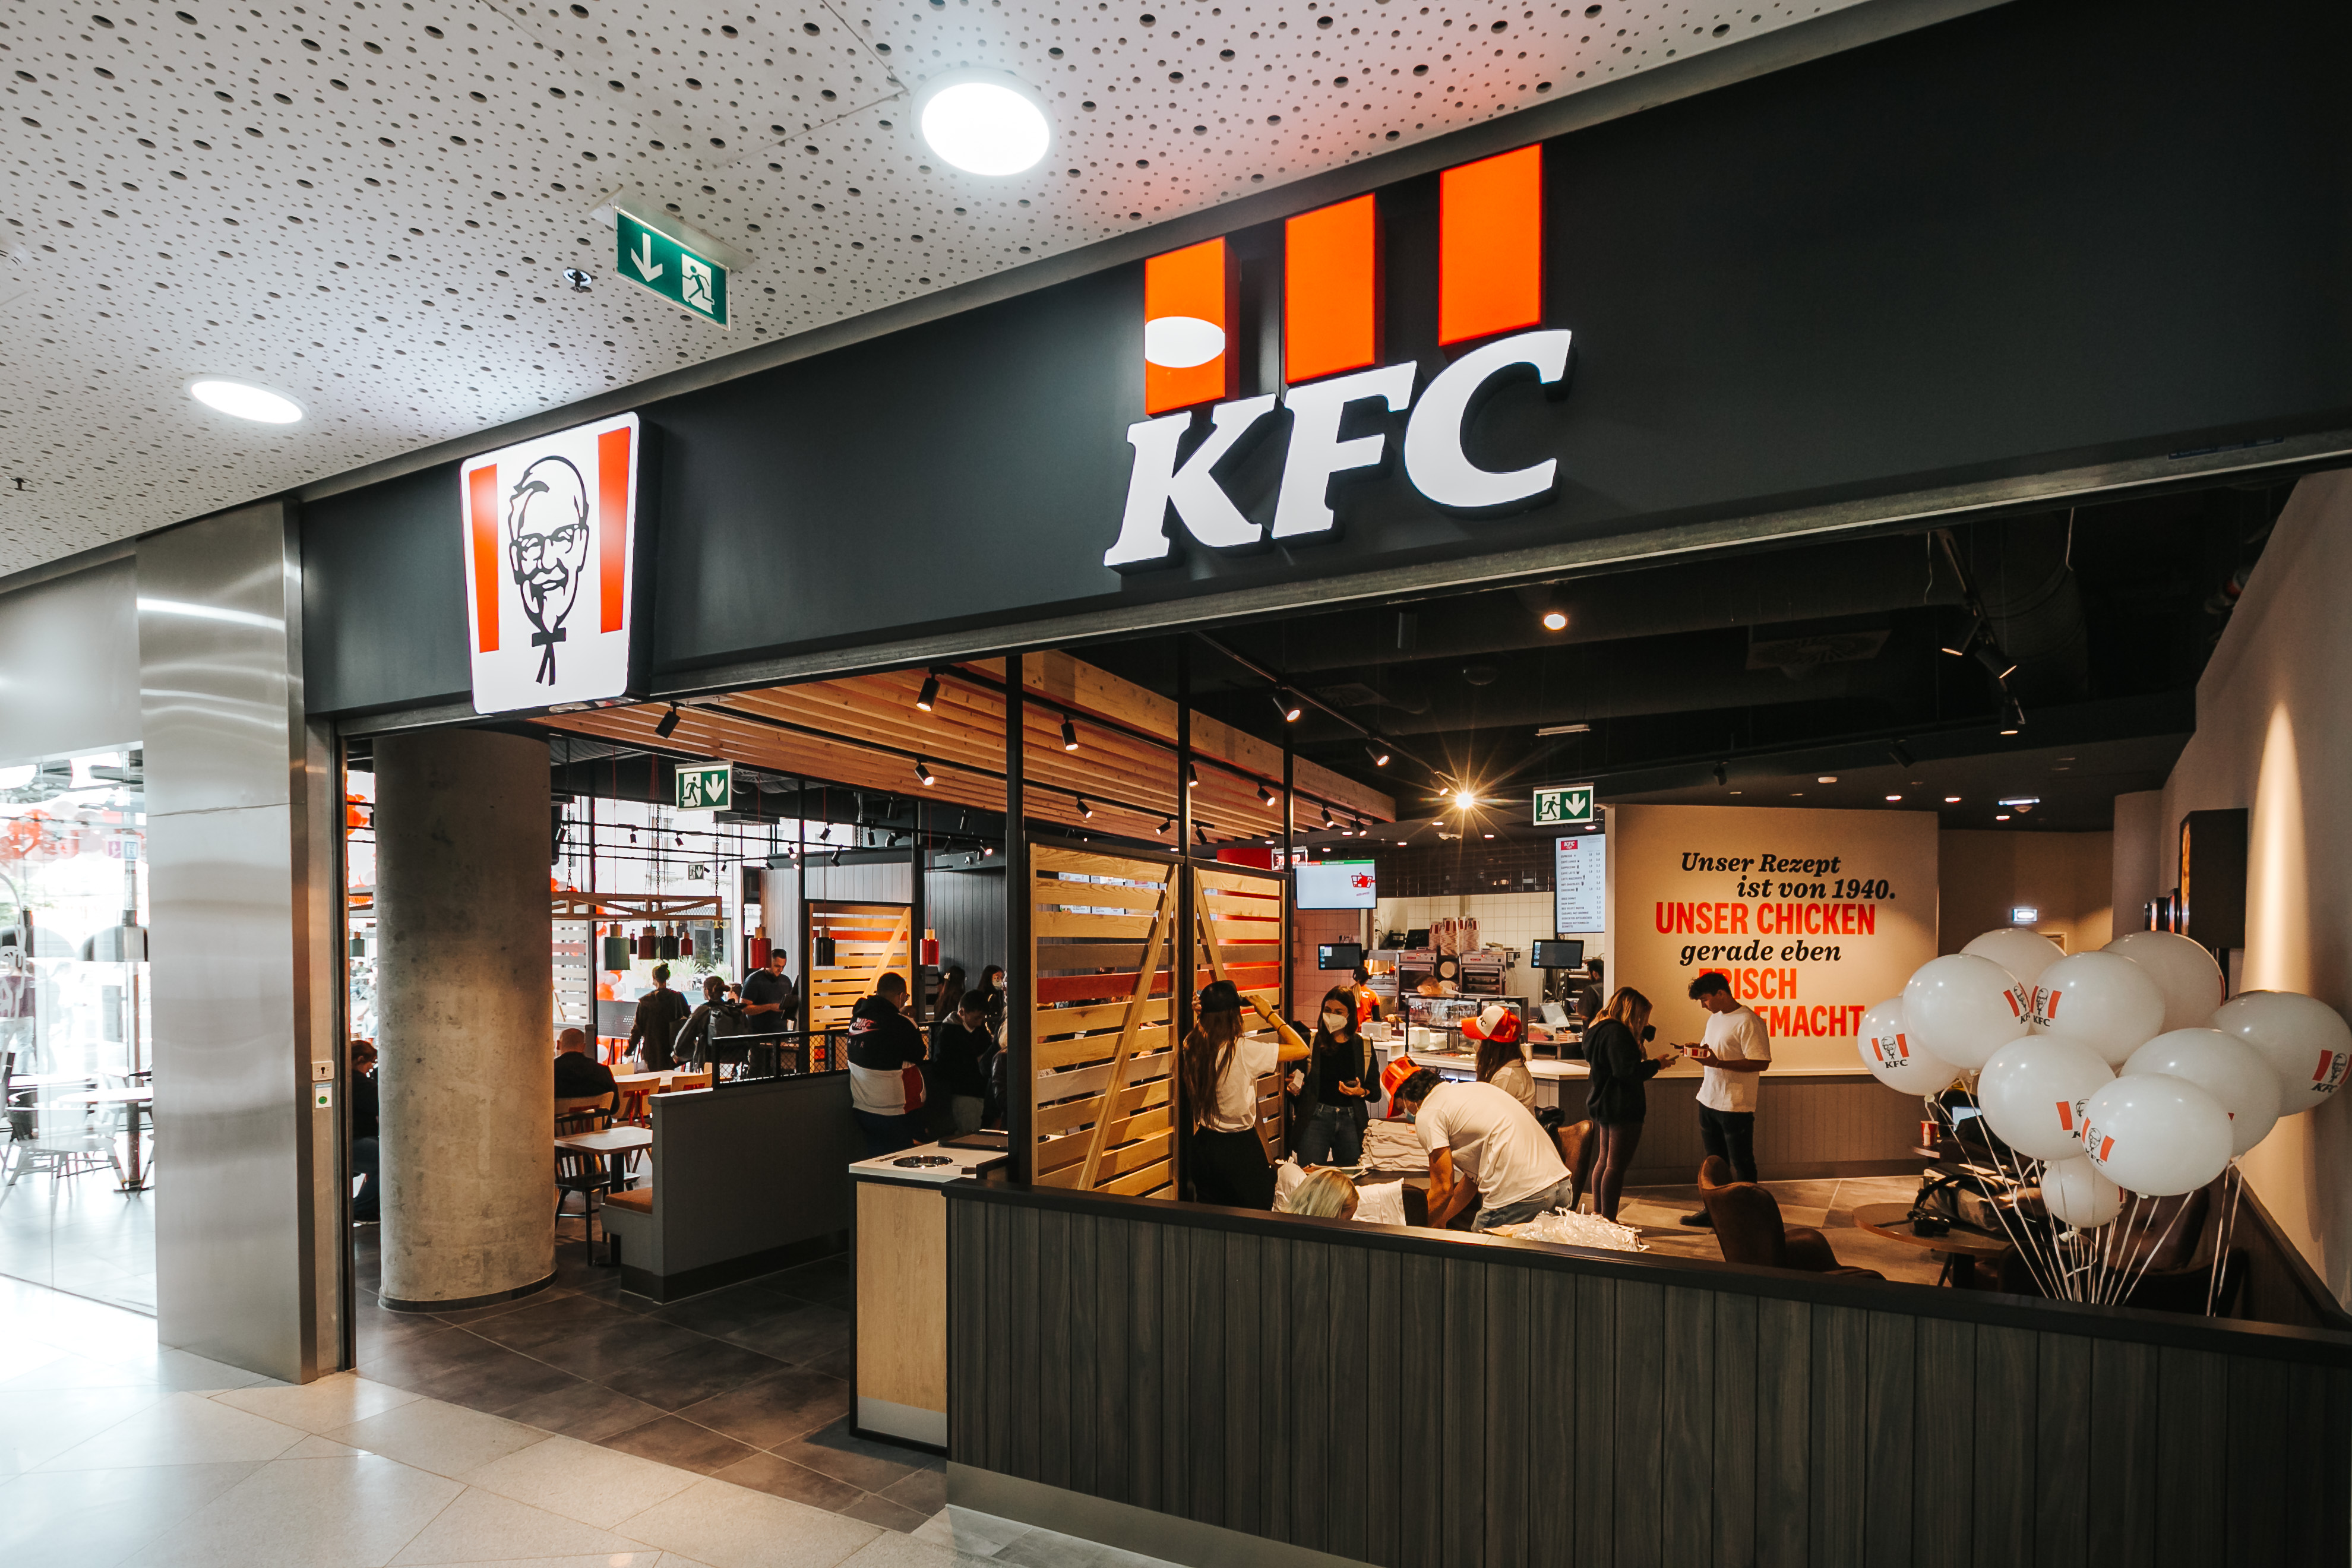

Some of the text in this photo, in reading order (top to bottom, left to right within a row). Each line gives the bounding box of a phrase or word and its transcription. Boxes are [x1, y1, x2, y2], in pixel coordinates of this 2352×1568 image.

[1103, 329, 1573, 567] KFC
[1681, 852, 1842, 877] Unser Rezept
[1737, 874, 1896, 900] ist von 1940.
[1655, 902, 1876, 935] UNSER CHICKEN
[1679, 939, 1842, 966] gerade eben
[2032, 1015, 2050, 1027] KFC
[1885, 1059, 1908, 1068] KFC
